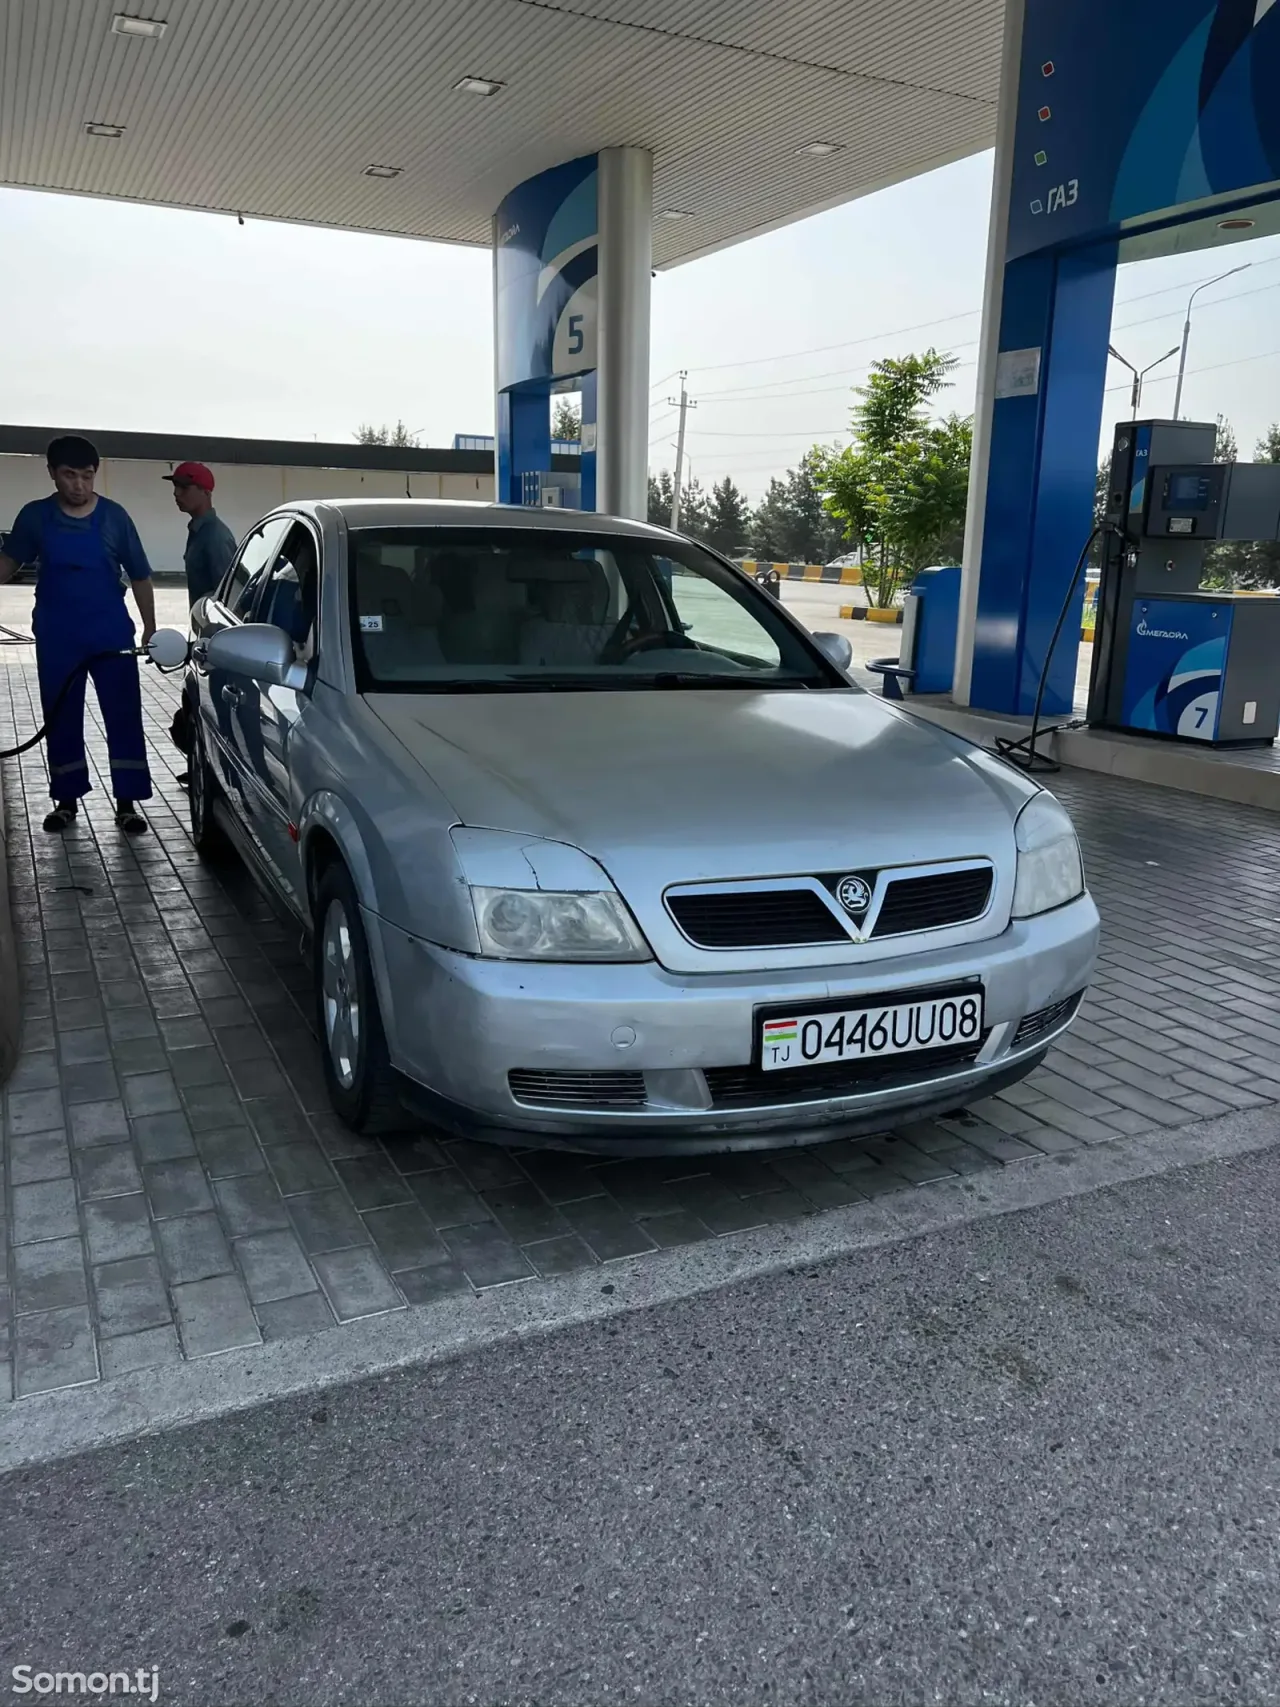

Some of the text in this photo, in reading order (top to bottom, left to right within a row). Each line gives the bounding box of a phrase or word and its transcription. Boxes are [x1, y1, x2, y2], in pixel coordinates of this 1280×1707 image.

[1046, 178, 1079, 214] ГАЗ
[568, 314, 584, 354] 5
[1194, 706, 1208, 729] 7
[801, 998, 978, 1060] 0446UU08
[772, 1045, 790, 1063] TJ
